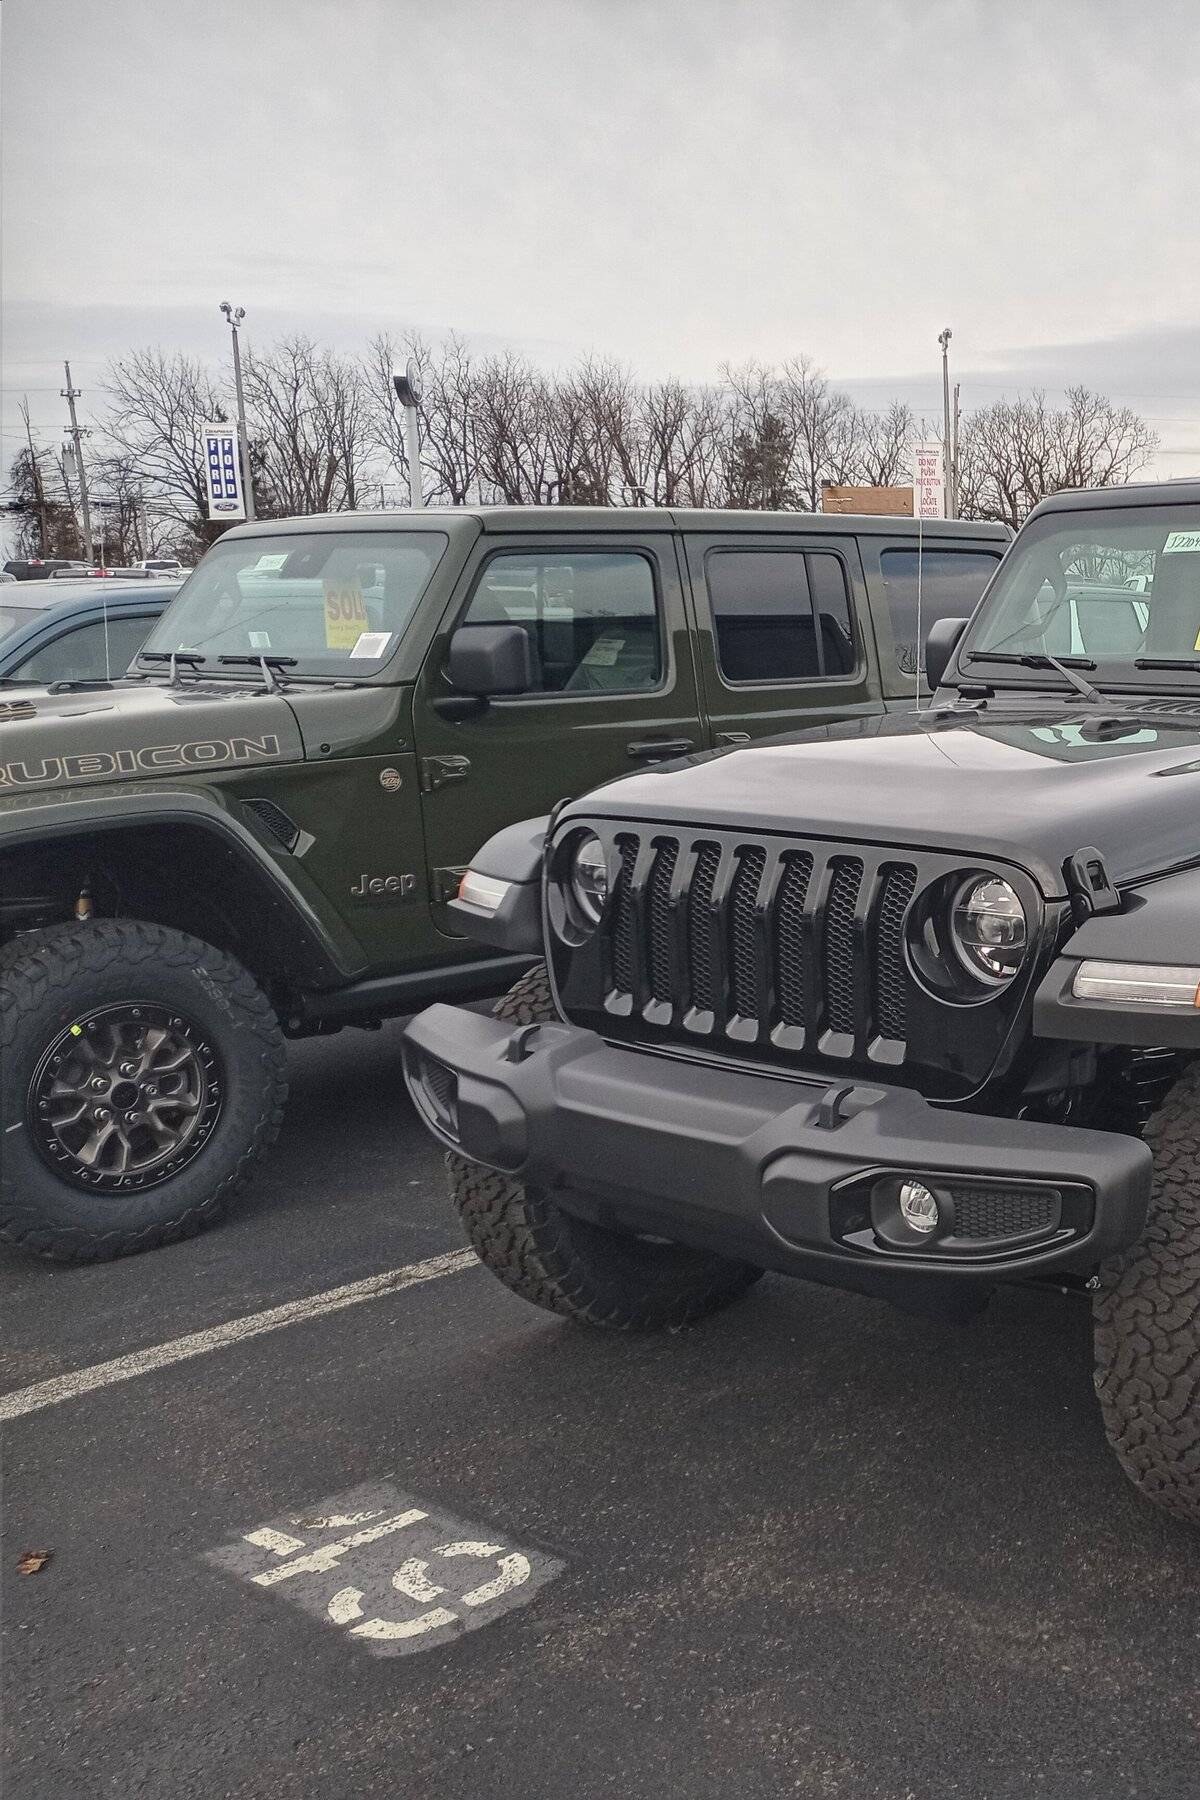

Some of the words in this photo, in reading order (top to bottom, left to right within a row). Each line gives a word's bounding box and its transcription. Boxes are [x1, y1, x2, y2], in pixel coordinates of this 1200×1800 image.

[209, 440, 221, 495] FORD
[224, 440, 236, 495] FORD
[918, 458, 926, 466] DO
[927, 458, 936, 466] NOT
[920, 467, 935, 476] PUSH
[0, 735, 280, 787] UBICON
[351, 874, 416, 896] Jeep
